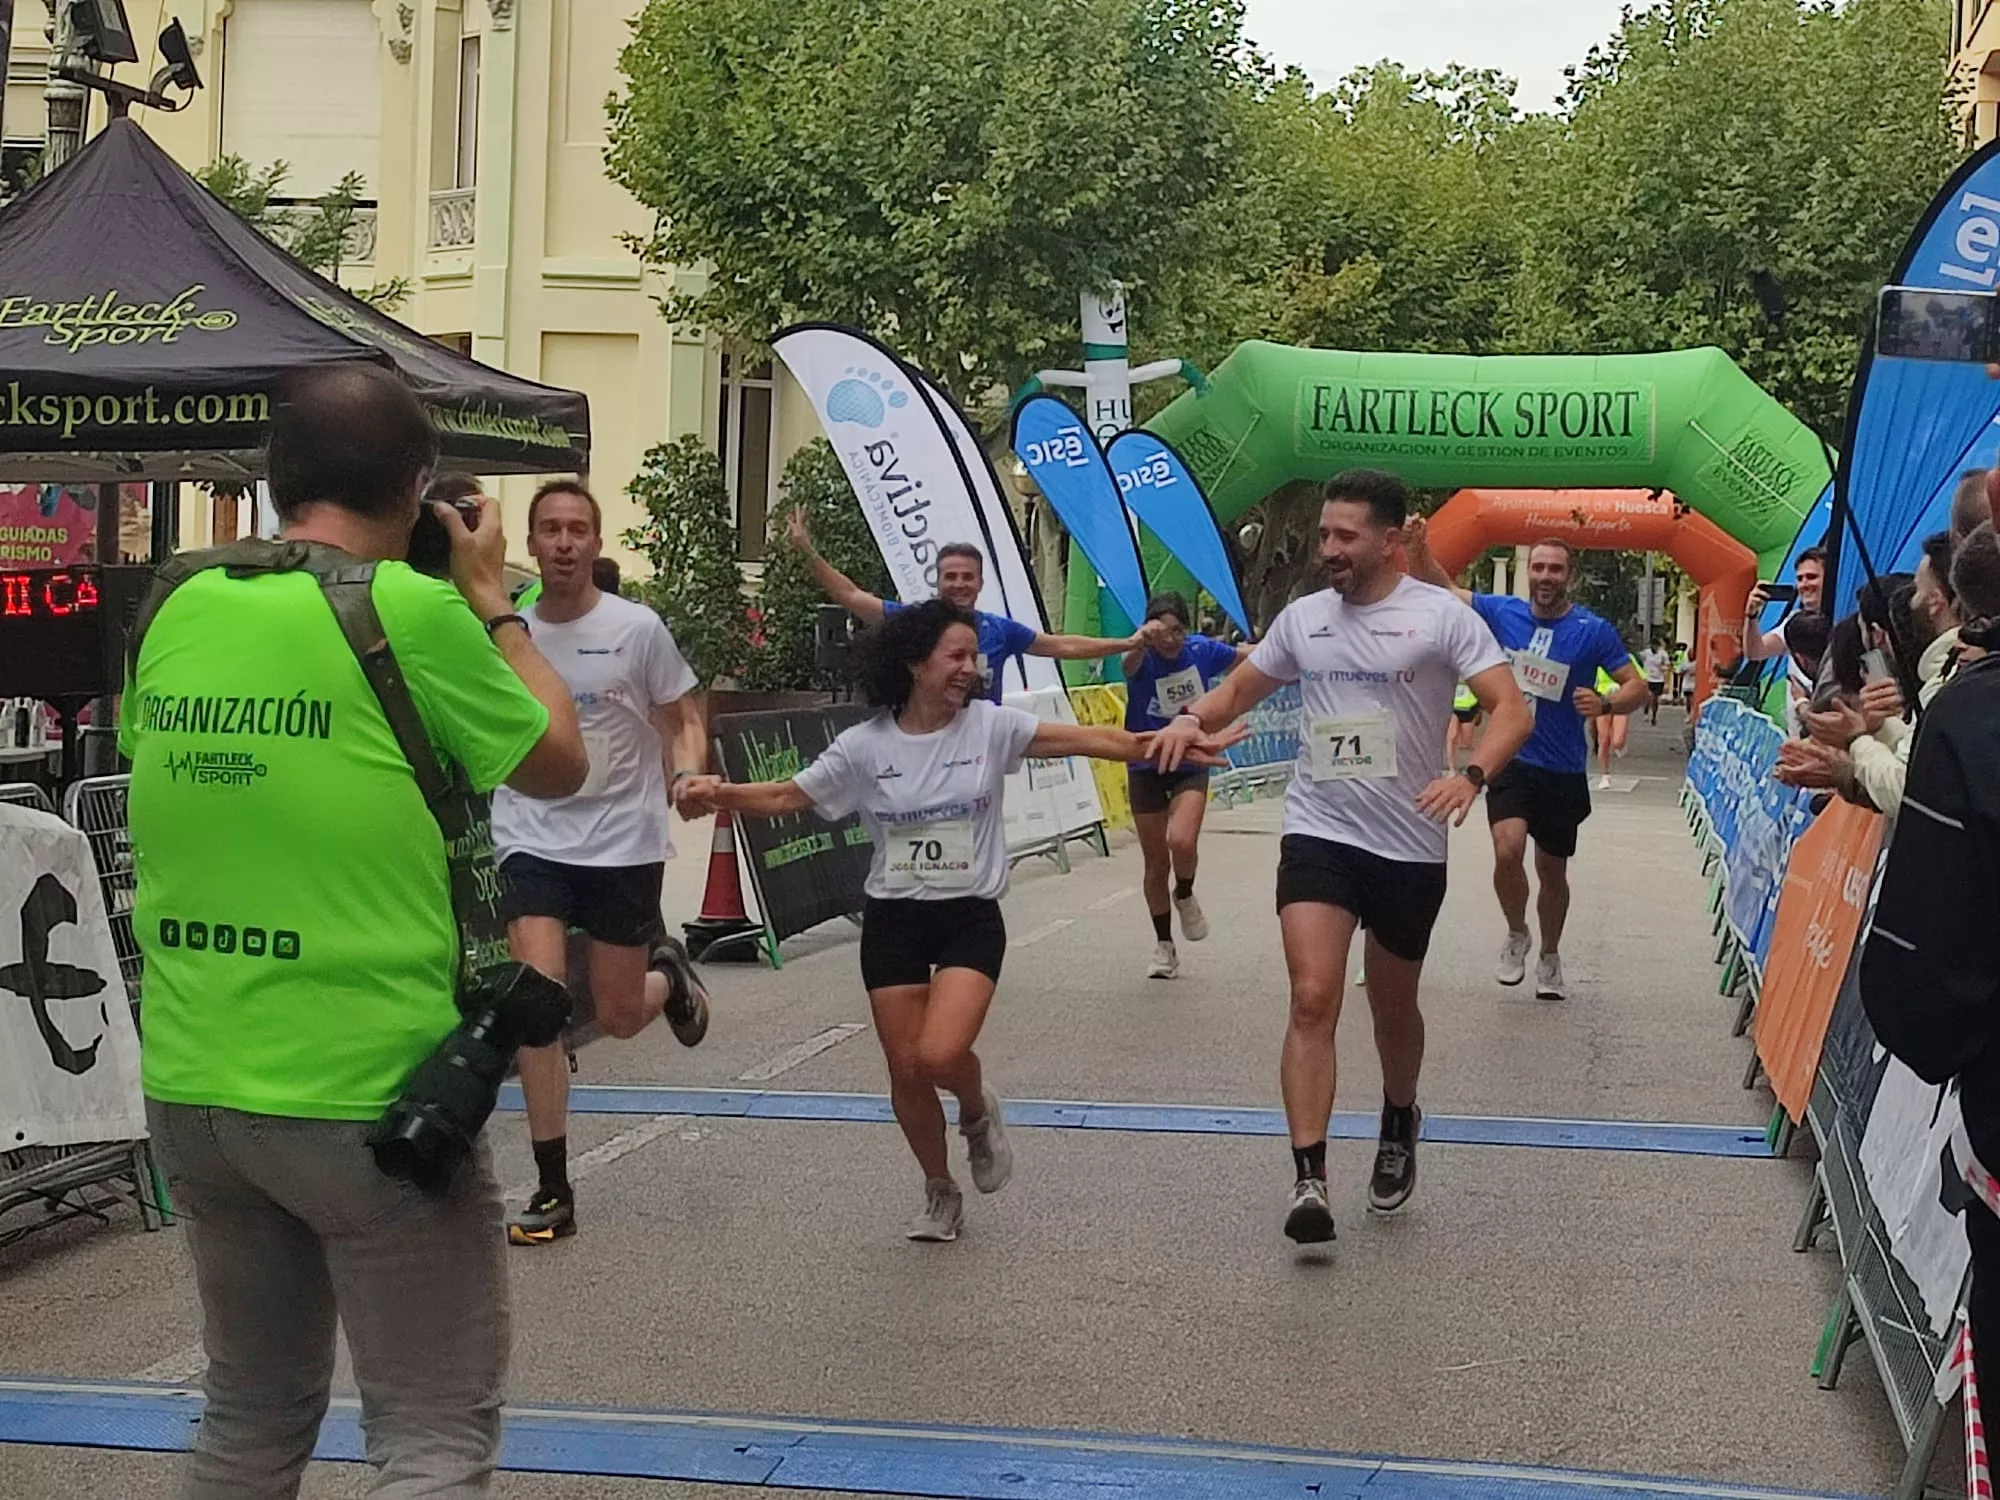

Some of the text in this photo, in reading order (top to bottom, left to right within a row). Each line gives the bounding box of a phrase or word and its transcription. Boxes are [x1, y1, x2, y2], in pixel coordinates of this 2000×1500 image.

[44, 321, 184, 353] Sport
[1310, 385, 1640, 439] FARTLECK SPORT
[1440, 445, 1450, 456] Y
[1524, 446, 1549, 457] DE
[1553, 446, 1629, 457] EVENTOS
[1614, 501, 1669, 515] Huesca
[1329, 670, 1389, 682] mueves
[1522, 664, 1558, 686] 1010
[140, 689, 331, 739] ORGANIZACIÓN
[1330, 735, 1361, 757] 71
[908, 839, 942, 861] 70
